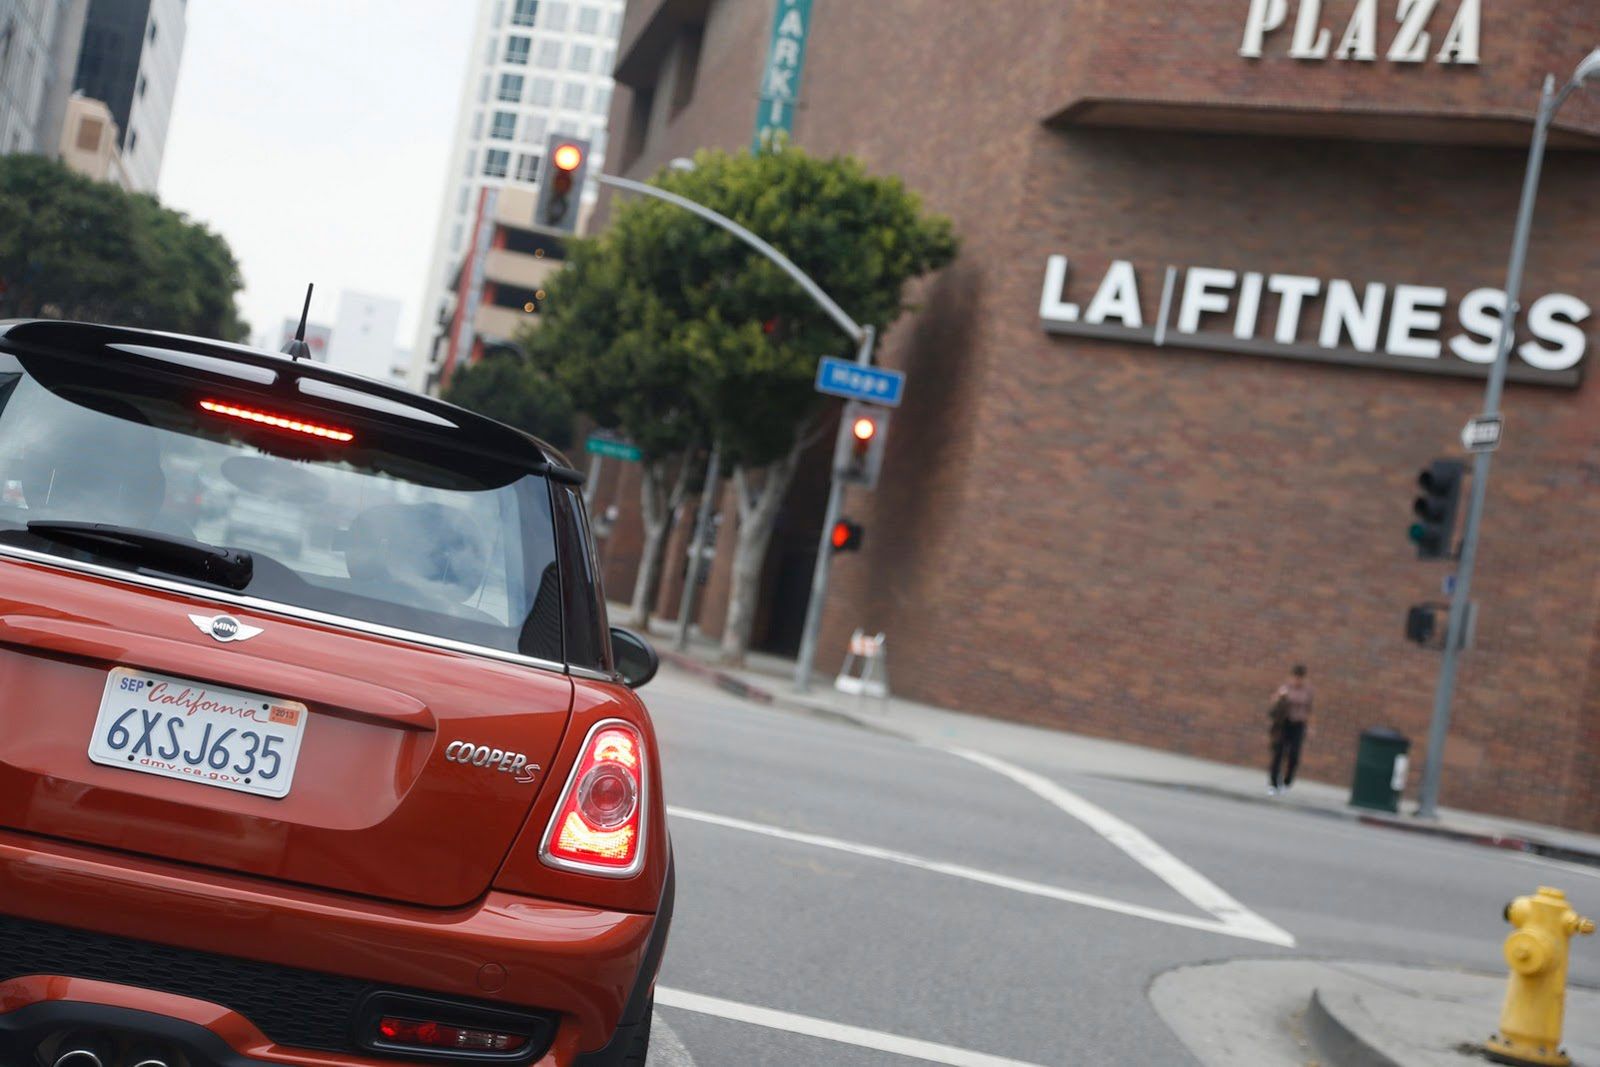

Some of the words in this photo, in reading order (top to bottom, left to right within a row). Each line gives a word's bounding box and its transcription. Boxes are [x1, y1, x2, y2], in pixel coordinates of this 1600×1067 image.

[1238, 0, 1481, 65] PLAZA
[760, 0, 804, 155] ARKI
[1038, 254, 1143, 329] LA
[1177, 265, 1592, 371] FITNESS
[213, 621, 238, 633] MINI
[120, 676, 144, 693] SEP
[147, 682, 268, 724] California
[275, 709, 295, 720] 2013
[107, 707, 285, 780] 6XSJ635
[445, 740, 527, 775] COOPER
[139, 757, 241, 784] dmv.ca.gov
